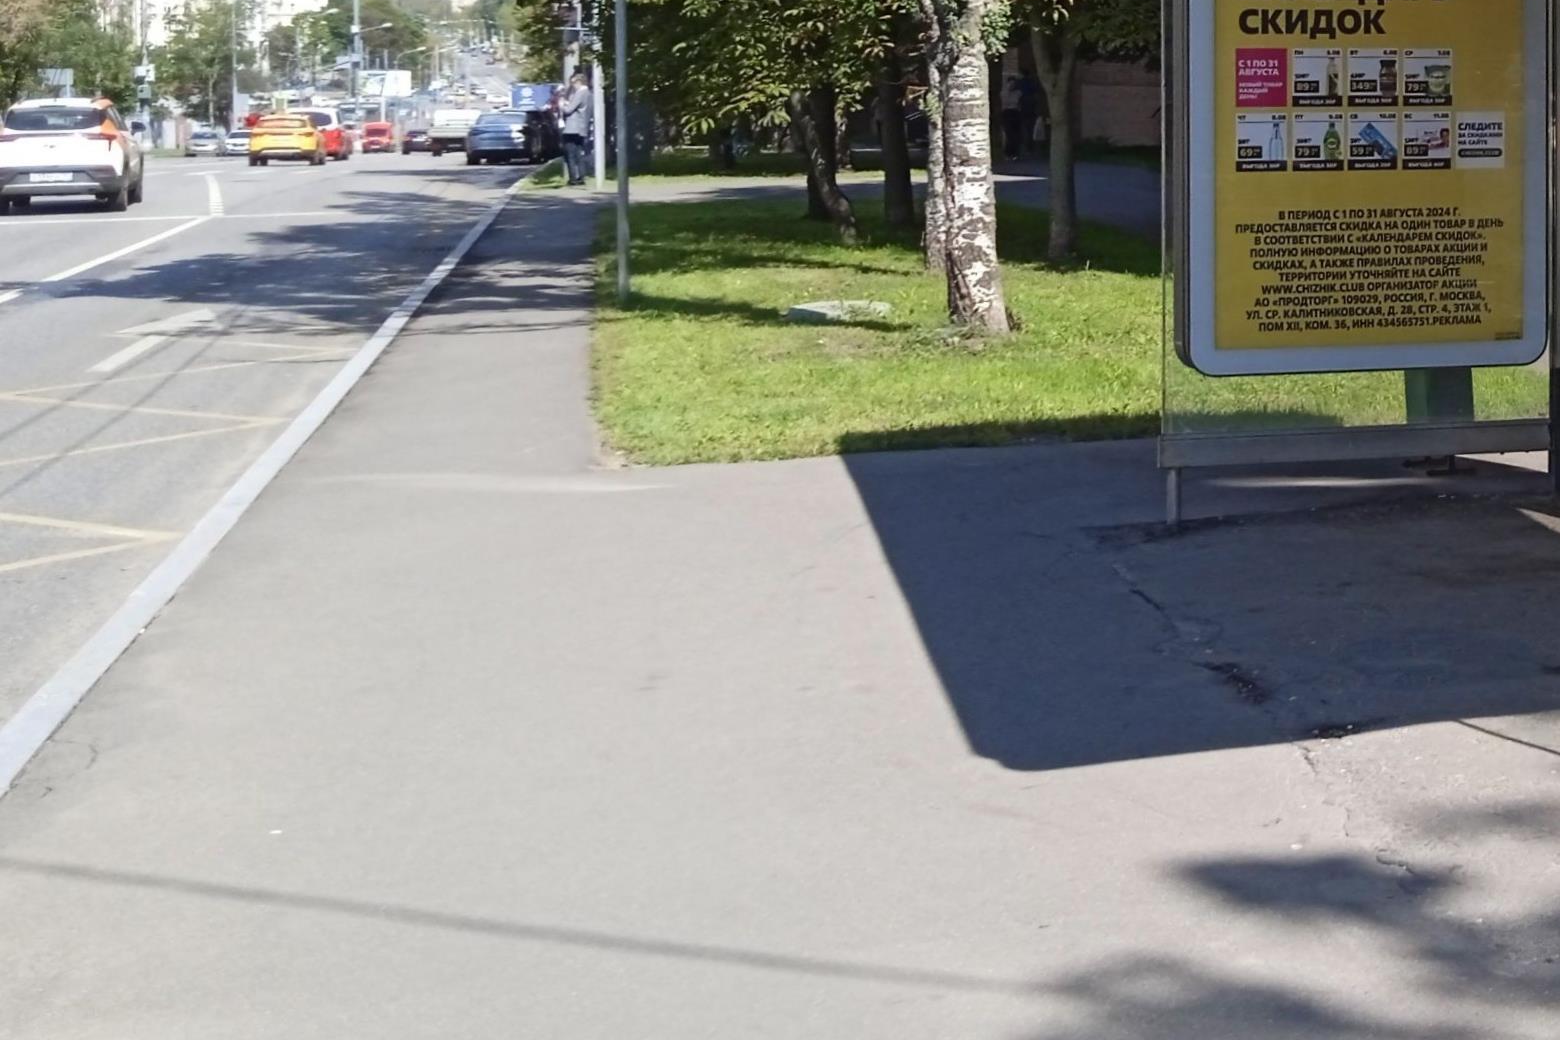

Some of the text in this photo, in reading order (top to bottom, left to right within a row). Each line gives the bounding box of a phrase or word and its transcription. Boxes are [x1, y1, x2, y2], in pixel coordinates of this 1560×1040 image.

[1239, 9, 1386, 39] СКИДОК
[1458, 123, 1502, 131] СЛЕДИТЕ
[1288, 210, 1330, 221] ПЕРИОД
[1349, 209, 1364, 219] ПО
[1367, 209, 1378, 218] 31
[1380, 208, 1424, 218] АВГУСТА
[1427, 207, 1450, 217] 2024
[1339, 221, 1382, 232] СКИДКА
[1385, 220, 1398, 230] НА
[1401, 220, 1432, 231] ОДИН
[1433, 219, 1466, 229] ТОВАР
[1478, 218, 1504, 230] ДЕНЬ
[1250, 247, 1298, 258] ПОЛНУЮ
[1393, 244, 1440, 254] ТОВАРАХ
[1443, 243, 1478, 254] АКЦИИ
[1253, 259, 1308, 271] СКИДКАХ,
[1319, 258, 1354, 268] ТАКЖЕ
[1357, 257, 1412, 268] ПРАВИЛАХ
[1349, 267, 1410, 280] УТОЧНЯЙТЕ
[1413, 268, 1426, 278] НА
[1429, 265, 1460, 278] САЙТЕ
[1255, 297, 1270, 307] АО
[1384, 293, 1426, 304] РОССИЯ,
[1439, 292, 1486, 303] МОСКВА,
[1247, 310, 1264, 320] УЛ.
[1265, 310, 1280, 320] СР.
[1386, 306, 1398, 317] Д.
[1418, 305, 1440, 315] СТР.
[1442, 304, 1452, 315] 4,
[1453, 303, 1482, 314] ЭТАЖ
[1259, 322, 1284, 332] ПОМ
[1305, 320, 1332, 331] КОМ.
[1353, 319, 1374, 329] ИНН
